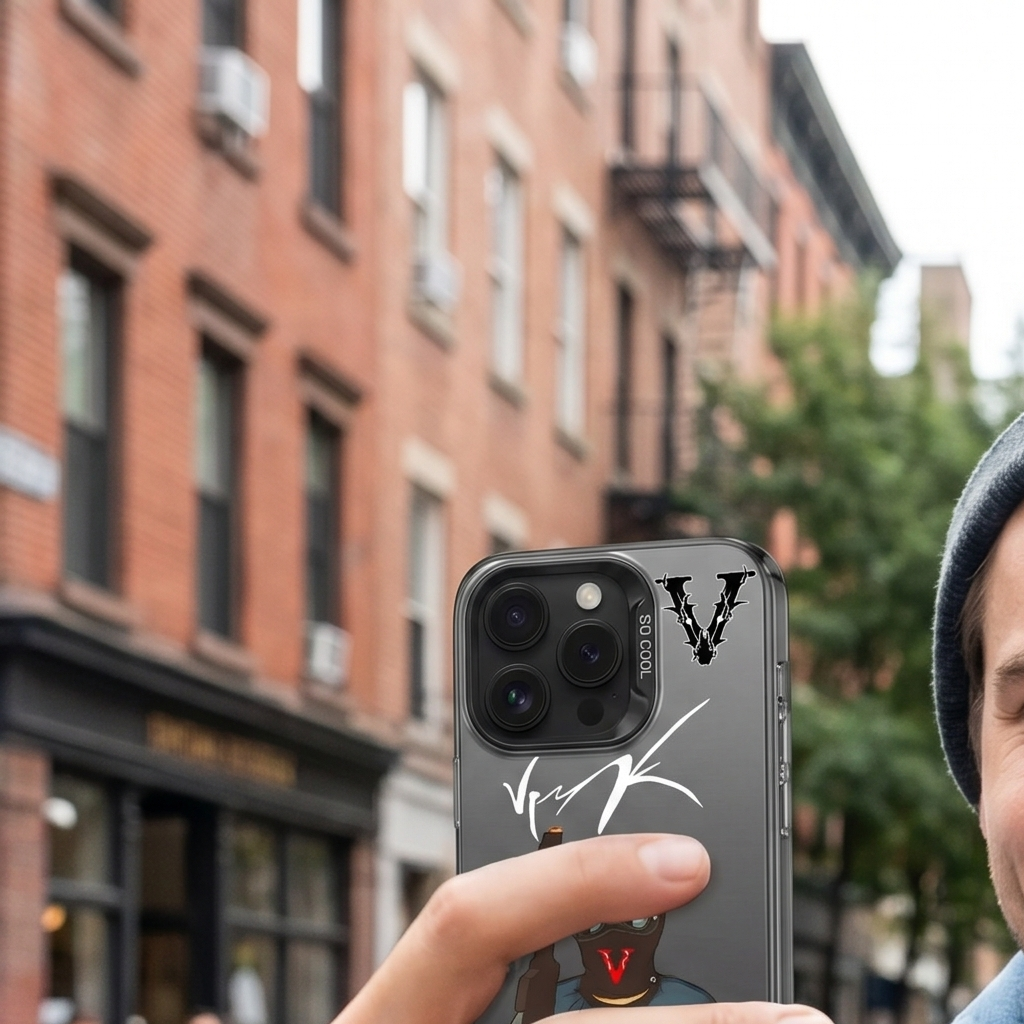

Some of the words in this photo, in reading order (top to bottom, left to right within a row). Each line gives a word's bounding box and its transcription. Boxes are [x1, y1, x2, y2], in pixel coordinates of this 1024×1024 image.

[639, 614, 652, 636] SO
[639, 639, 652, 680] COOL
[597, 947, 636, 986] V
